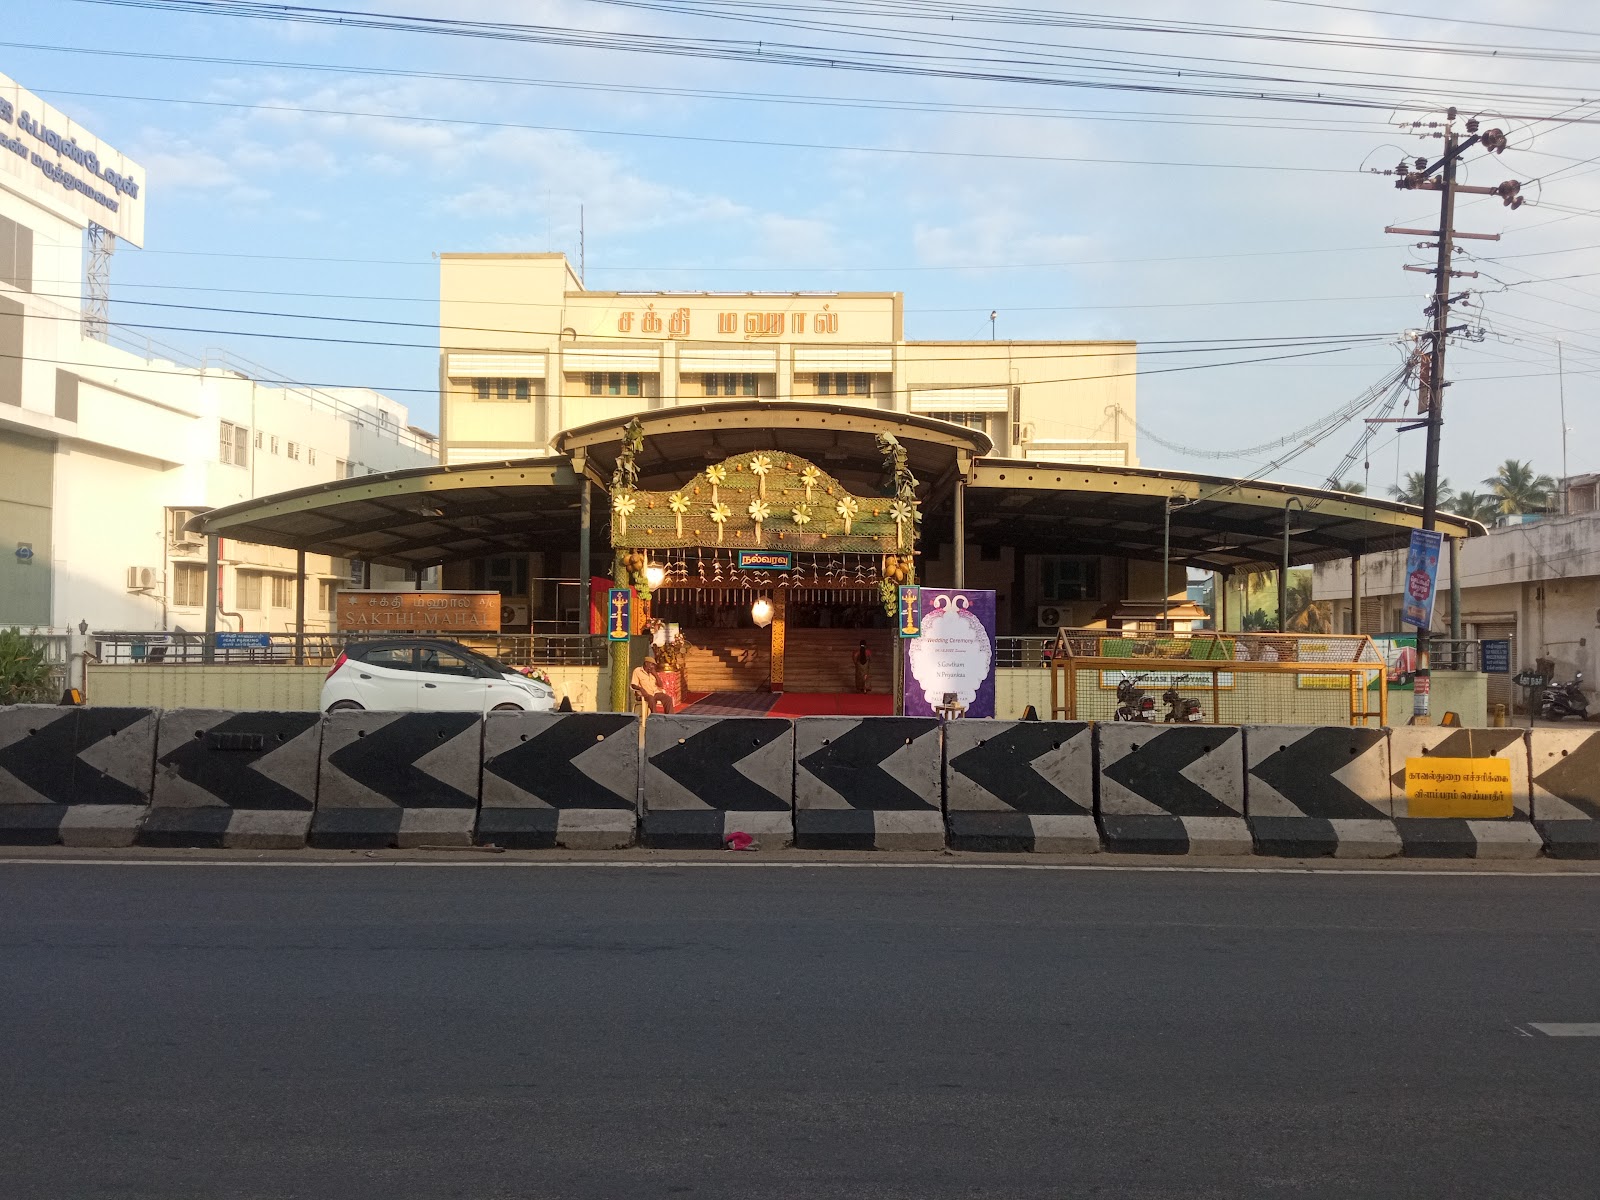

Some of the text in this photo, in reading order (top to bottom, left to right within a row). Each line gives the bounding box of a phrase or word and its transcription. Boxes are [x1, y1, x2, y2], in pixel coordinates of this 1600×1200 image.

[31, 151, 119, 213] மருத்துவமனை
[617, 303, 839, 340] சக்தி மஹால்
[742, 553, 788, 566] நல்வரவு
[368, 595, 403, 609] சக்தி
[413, 596, 471, 610] மஹால்
[345, 612, 488, 625] SAKTHI MAHAL
[1409, 770, 1509, 783] காவல்துறை எச்சரிக்கை
[1414, 788, 1505, 802] விளம்பரம் செய்யாதீர்
